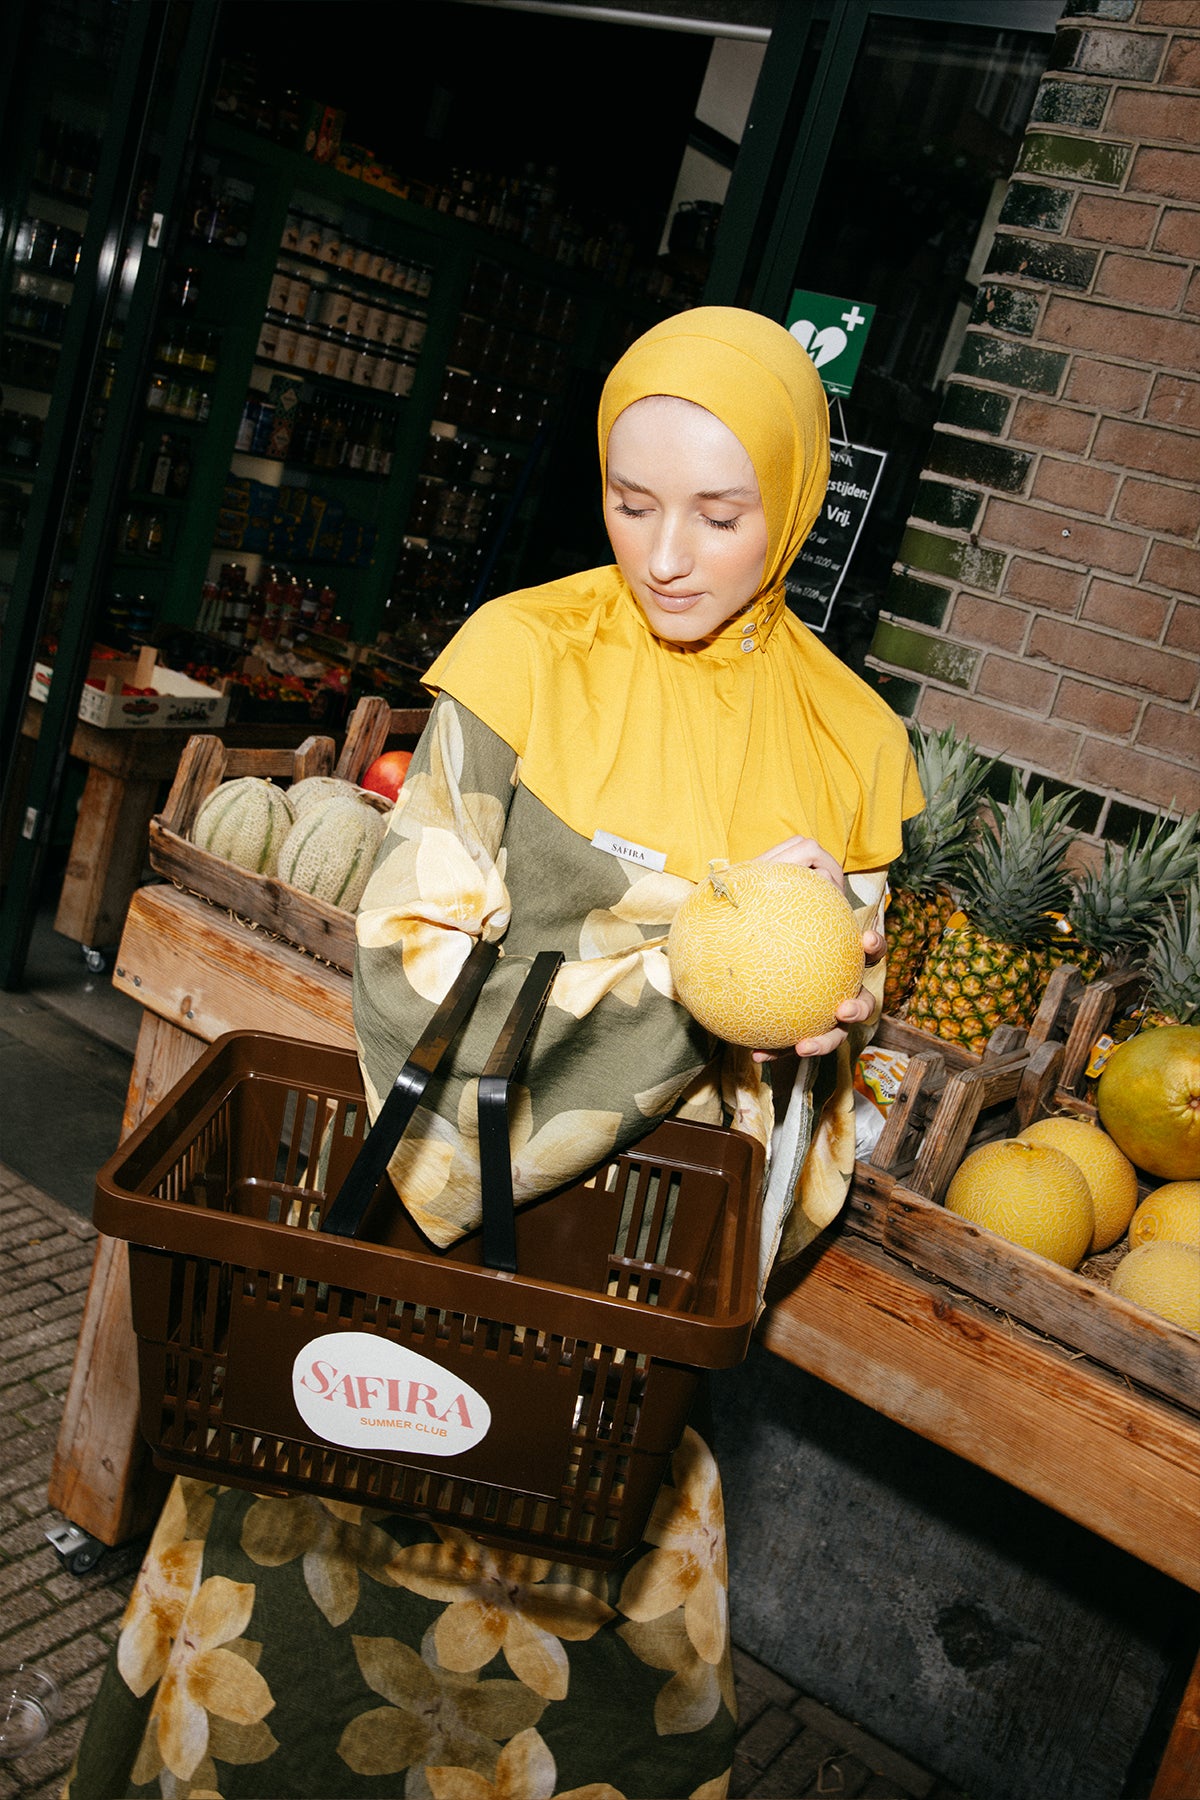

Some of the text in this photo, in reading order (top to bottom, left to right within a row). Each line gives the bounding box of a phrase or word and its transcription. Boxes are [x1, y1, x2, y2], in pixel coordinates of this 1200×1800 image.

[827, 504, 851, 527] Vrij.
[611, 843, 645, 860] SAFIRA
[300, 1360, 475, 1430] SAFIRA
[360, 1417, 448, 1438] SUMMER CLUB
